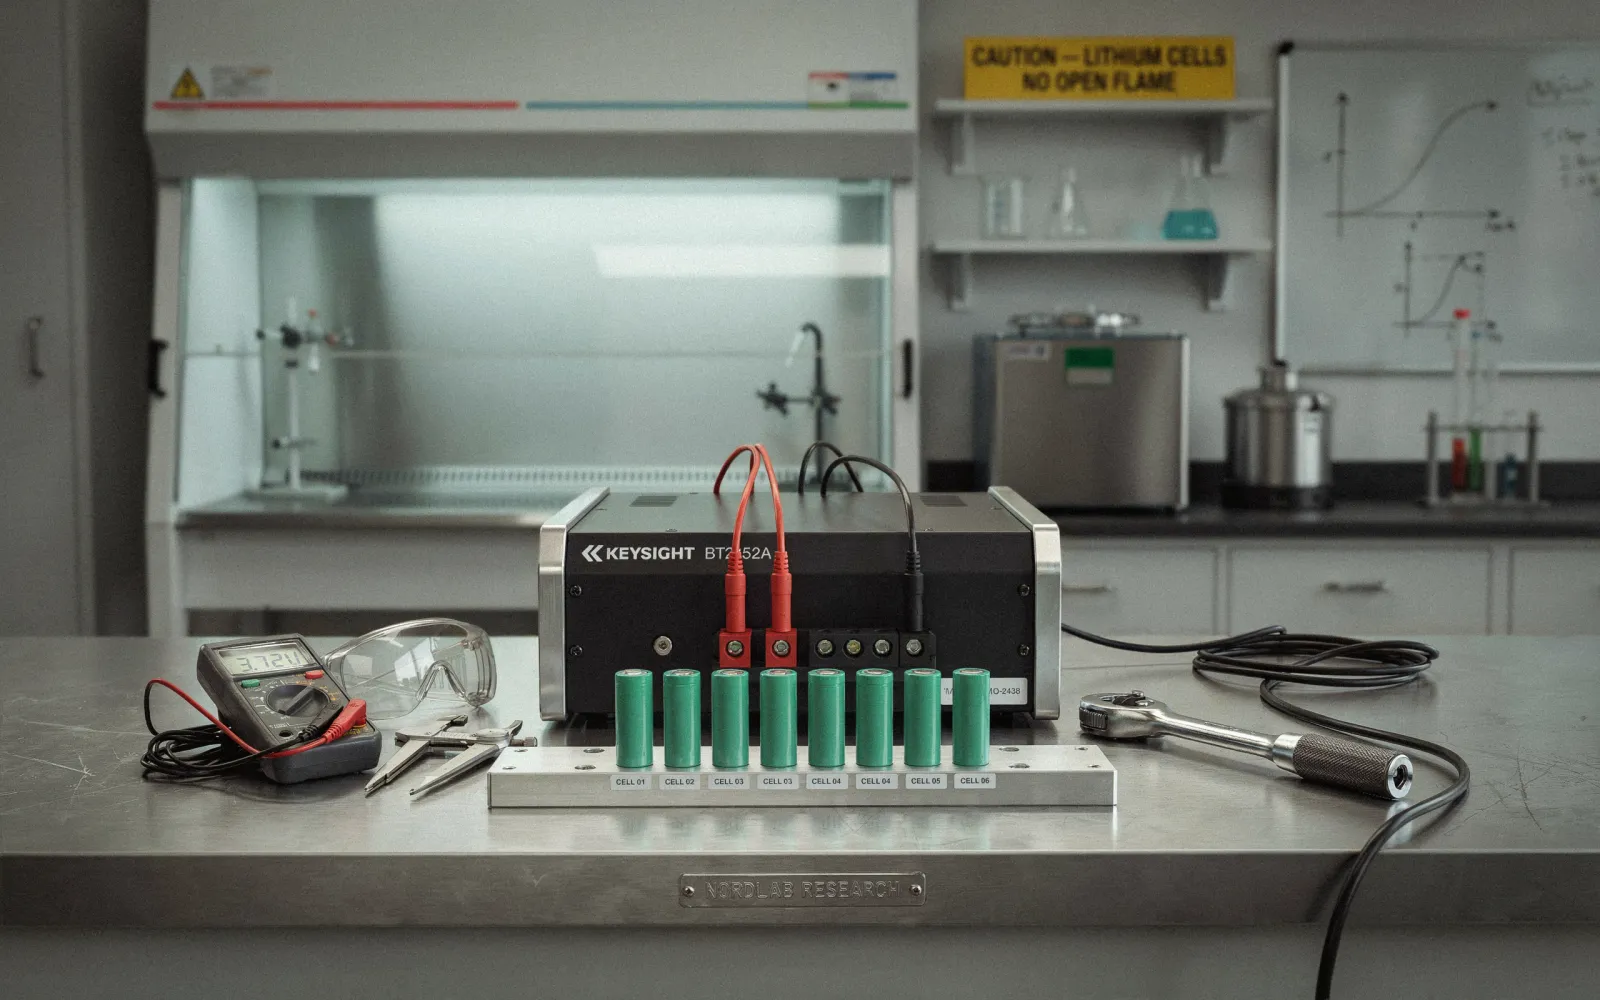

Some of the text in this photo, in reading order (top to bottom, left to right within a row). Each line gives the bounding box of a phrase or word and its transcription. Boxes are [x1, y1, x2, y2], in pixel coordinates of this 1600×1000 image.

[972, 45, 1057, 66] CAUTION
[1084, 45, 1162, 66] LITHIUM
[1167, 45, 1227, 66] CELLS
[1022, 71, 1177, 91] NO OPEN FLAME
[606, 546, 772, 560] KEYSIGHT BT252A
[615, 778, 645, 786] CELL 01
[705, 880, 900, 899] NORDLAB RESEARCH
